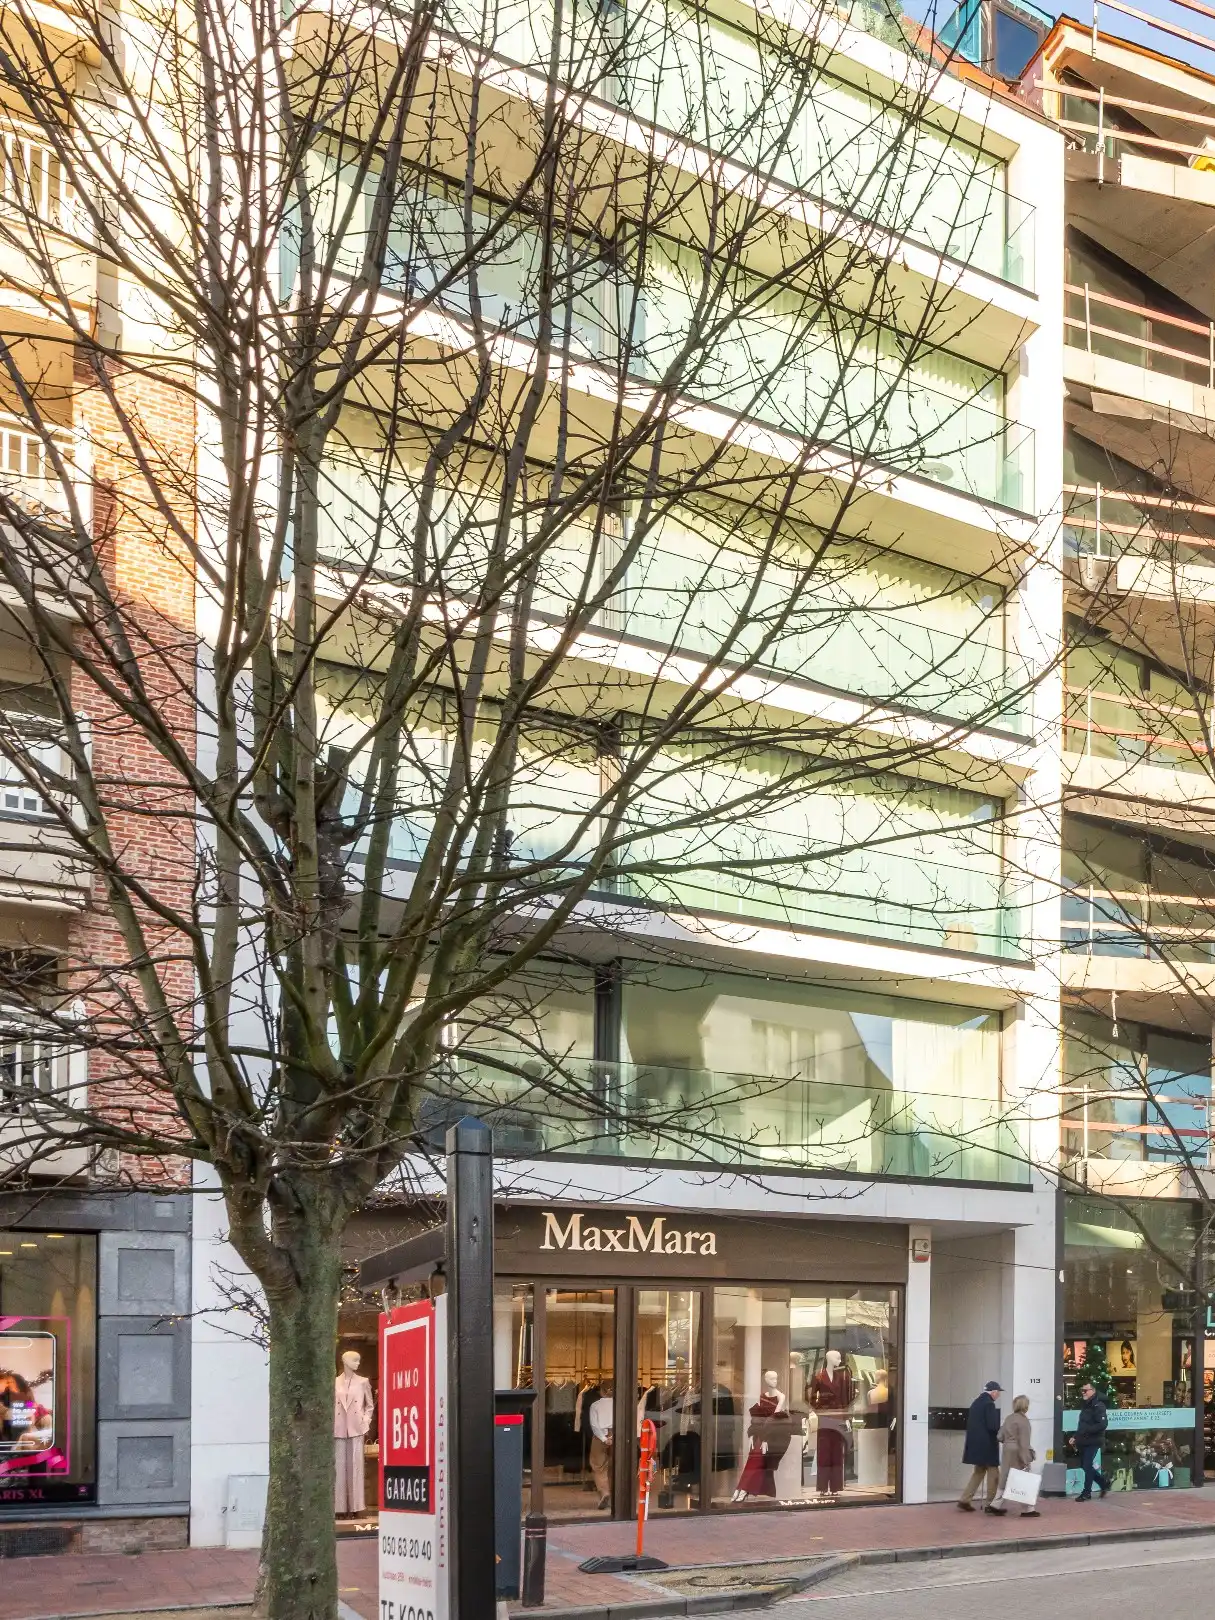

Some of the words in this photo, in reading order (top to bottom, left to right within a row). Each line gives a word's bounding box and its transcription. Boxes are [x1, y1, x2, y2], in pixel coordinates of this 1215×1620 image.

[539, 1211, 718, 1256] MaxMara
[392, 1367, 419, 1391] IMMO
[392, 1405, 419, 1450] BiS
[28, 1488, 45, 1499] XL
[386, 1477, 427, 1502] GARAGE
[382, 1535, 396, 1556] 050
[397, 1537, 407, 1558] 63
[409, 1538, 419, 1559] 20
[421, 1540, 432, 1561] 40
